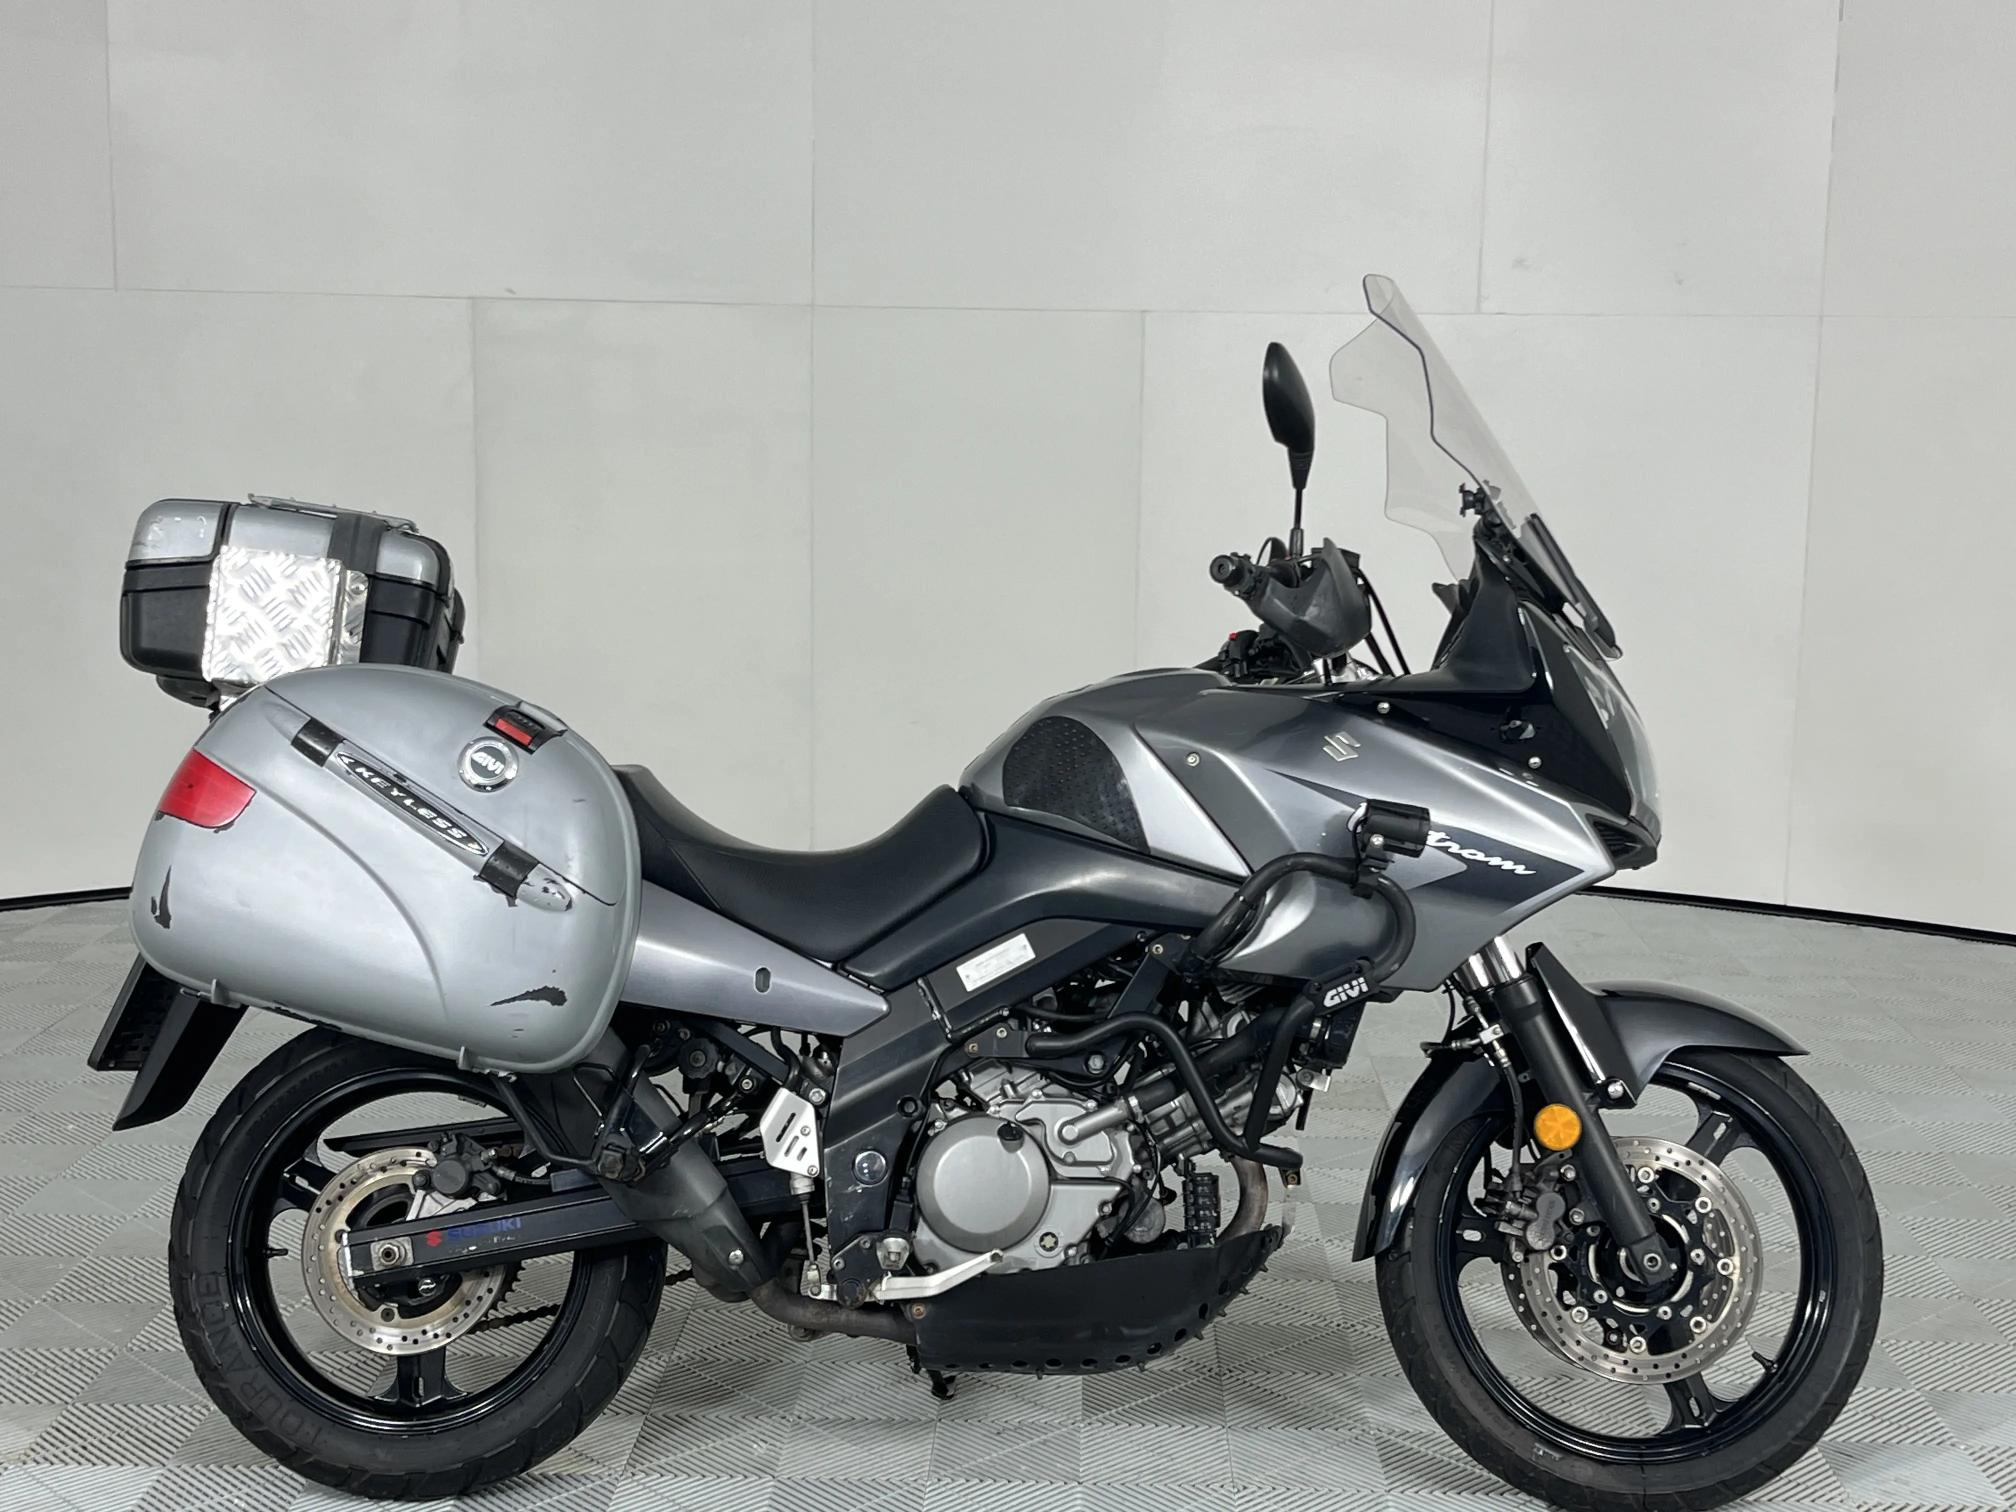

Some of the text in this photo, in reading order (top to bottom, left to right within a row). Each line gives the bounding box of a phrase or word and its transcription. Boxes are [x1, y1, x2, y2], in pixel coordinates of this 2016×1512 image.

[471, 751, 505, 775] GIVI
[354, 766, 468, 839] KEYLESS
[1323, 976, 1369, 1008] GIVI
